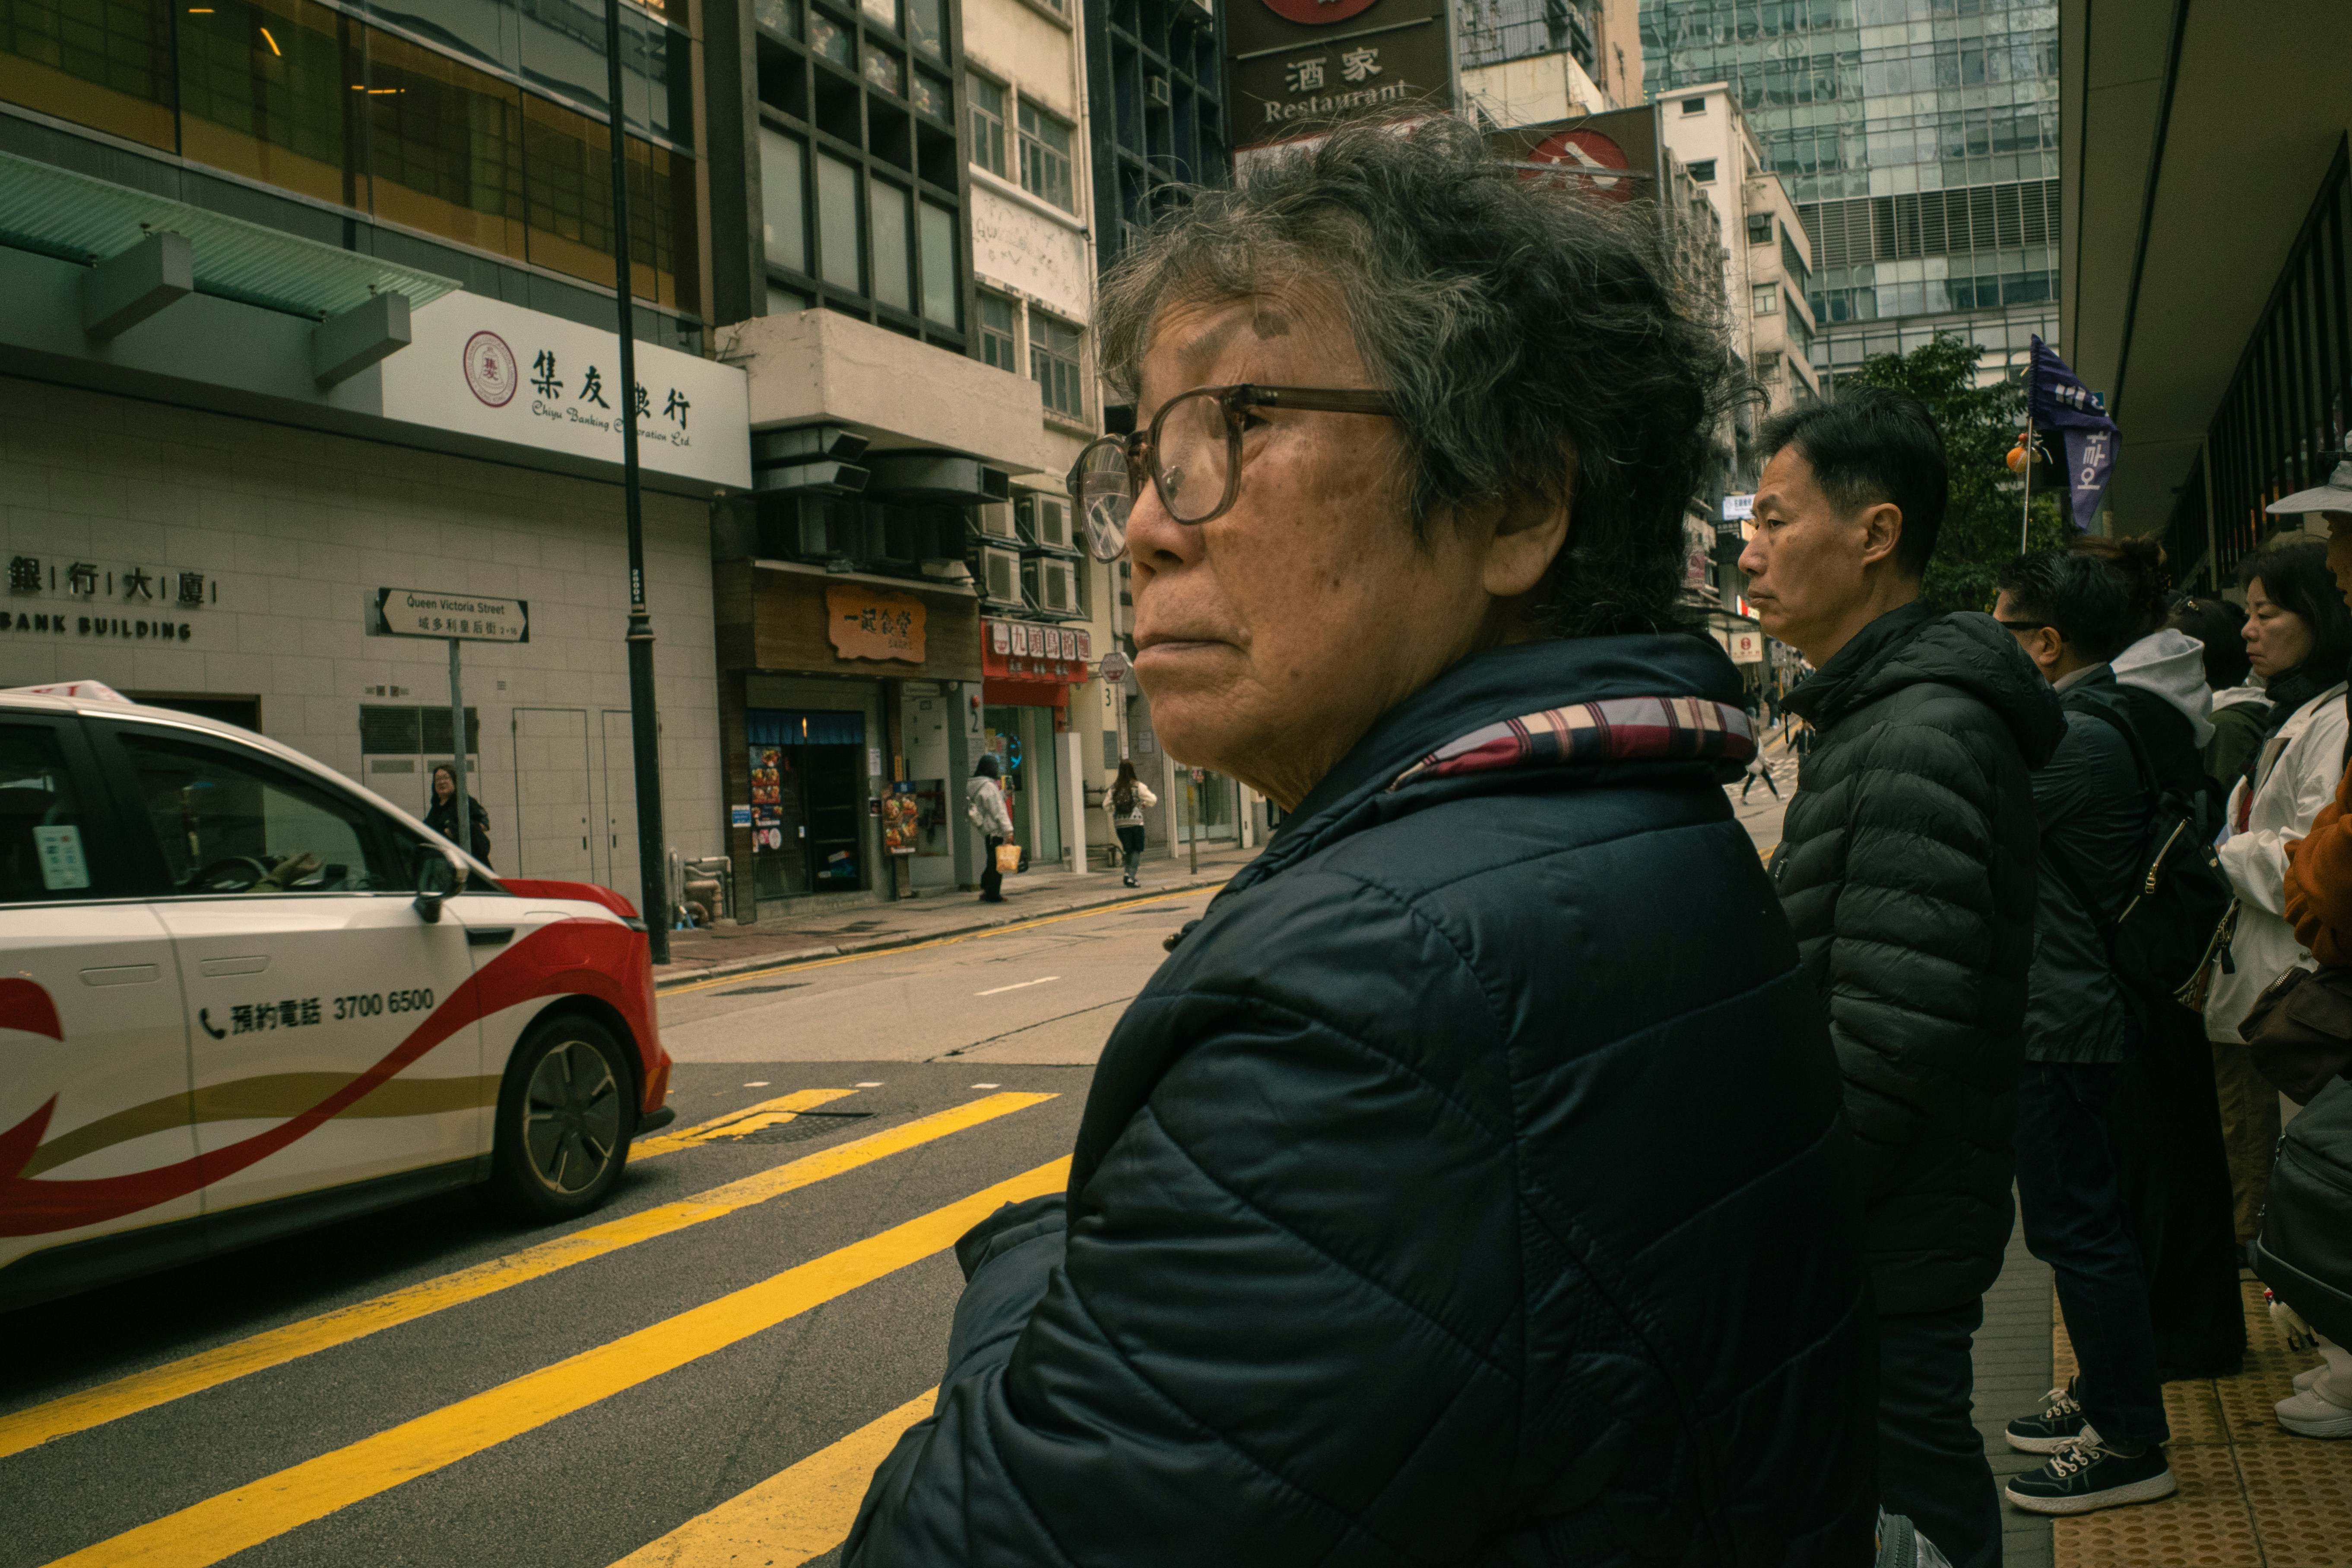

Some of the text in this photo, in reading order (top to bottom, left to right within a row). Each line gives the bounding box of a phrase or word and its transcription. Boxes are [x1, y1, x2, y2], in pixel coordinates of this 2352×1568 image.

[1285, 47, 1382, 92] 酒家
[1264, 79, 1405, 123] Restaurant
[532, 399, 562, 421] Chiyu
[566, 407, 609, 431] Banking
[407, 593, 504, 615] Queen Victoria Street
[0, 611, 191, 640] BANK BUILDING
[231, 988, 433, 1035] 預約電話 3700 6500
